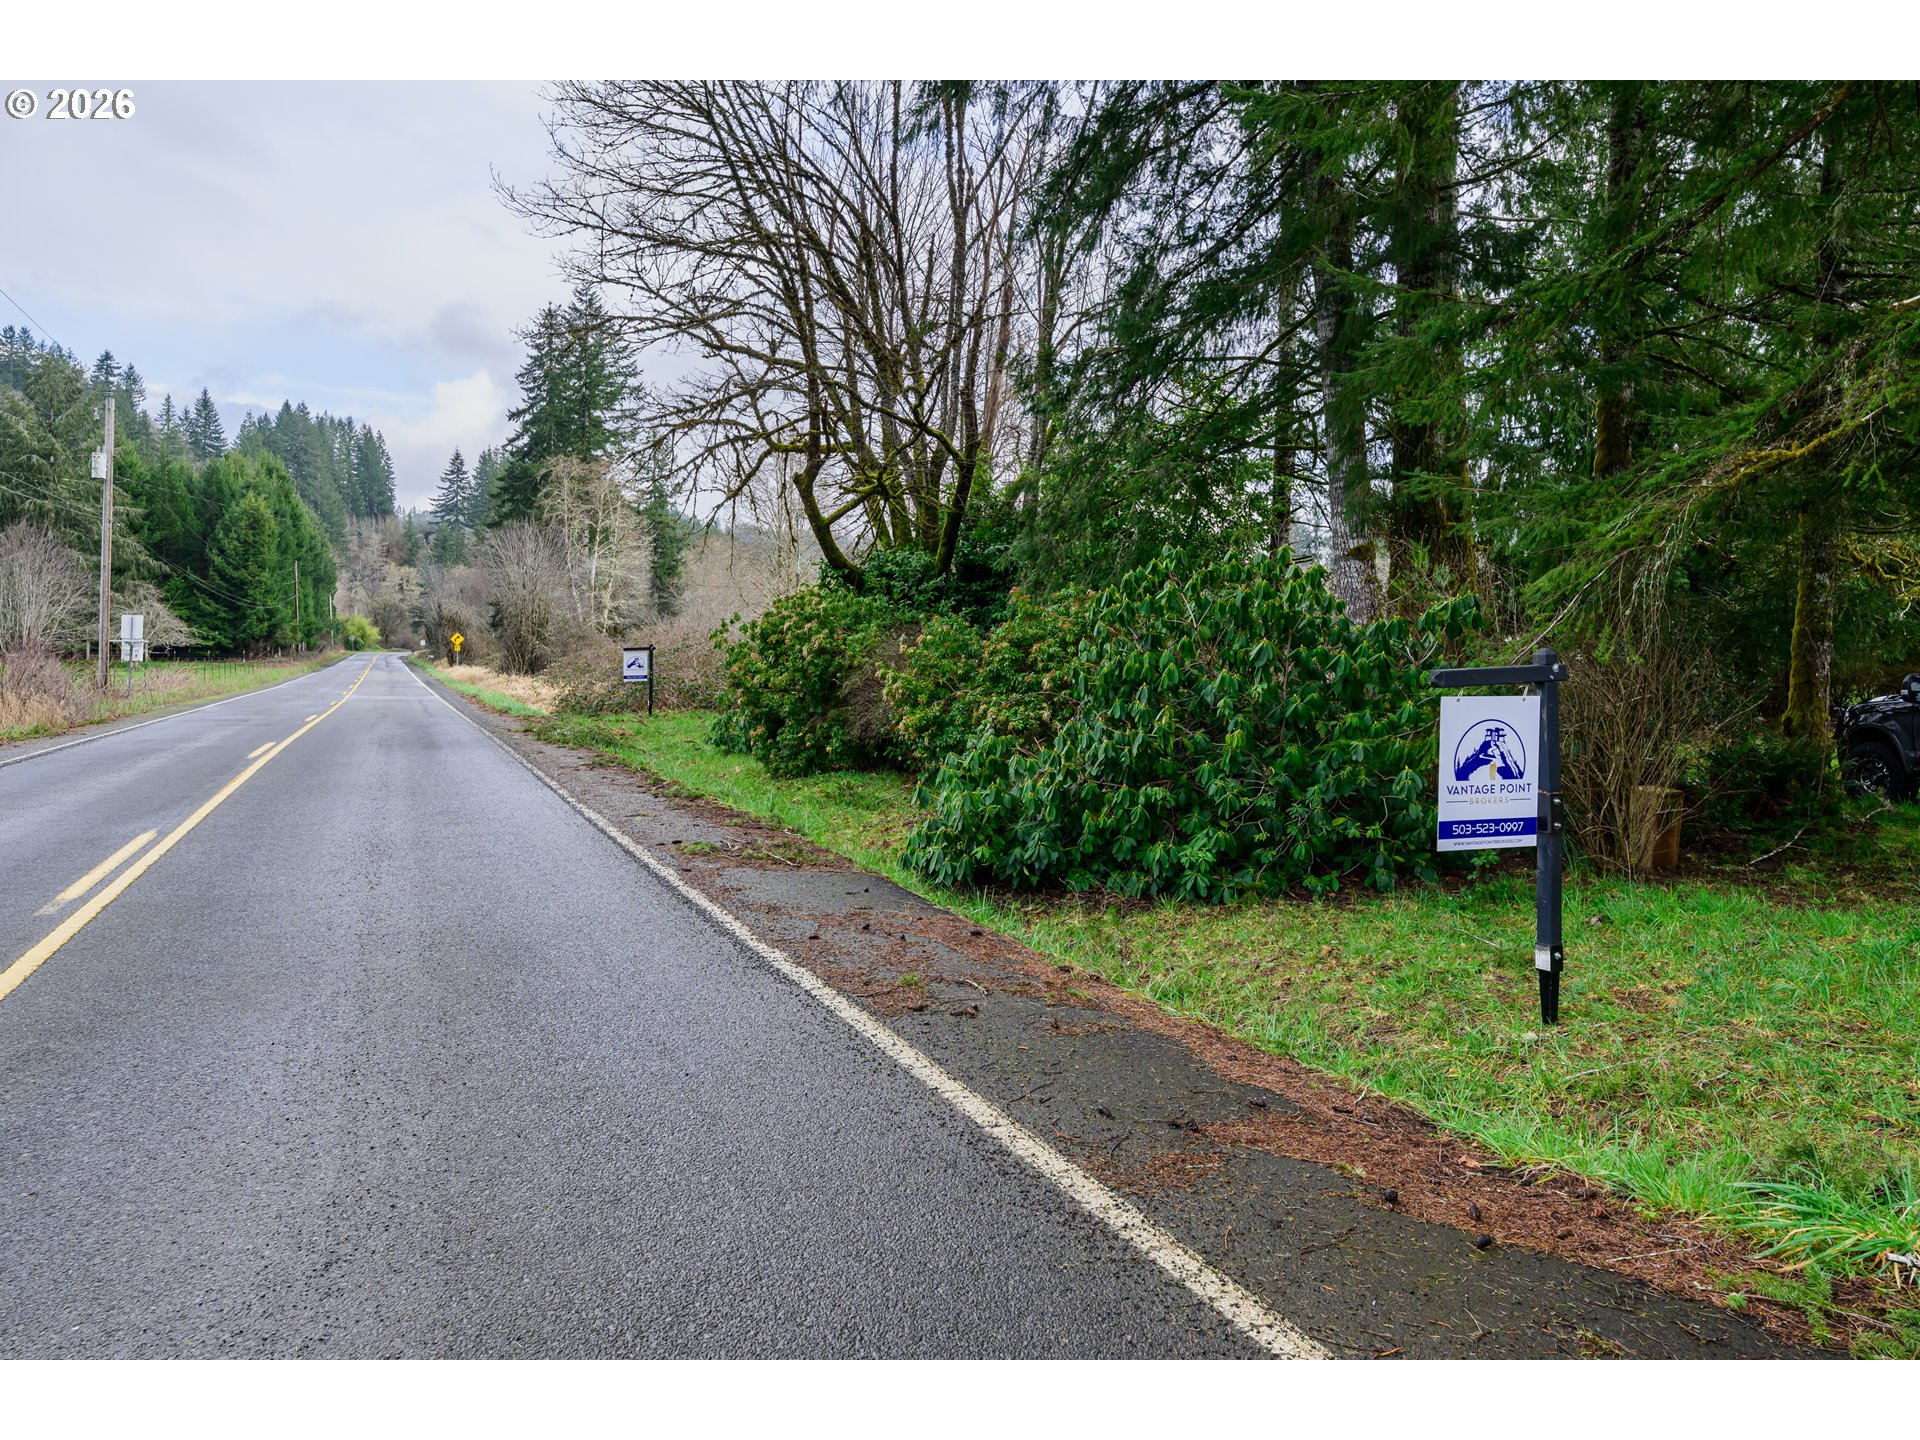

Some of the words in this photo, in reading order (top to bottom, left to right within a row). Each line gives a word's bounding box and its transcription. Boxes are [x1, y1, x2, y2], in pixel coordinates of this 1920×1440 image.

[1446, 784, 1496, 795] VANTAGE
[1499, 783, 1532, 794] POINT
[1469, 796, 1509, 805] BROKERS
[1452, 821, 1524, 835] 503-523-0997
